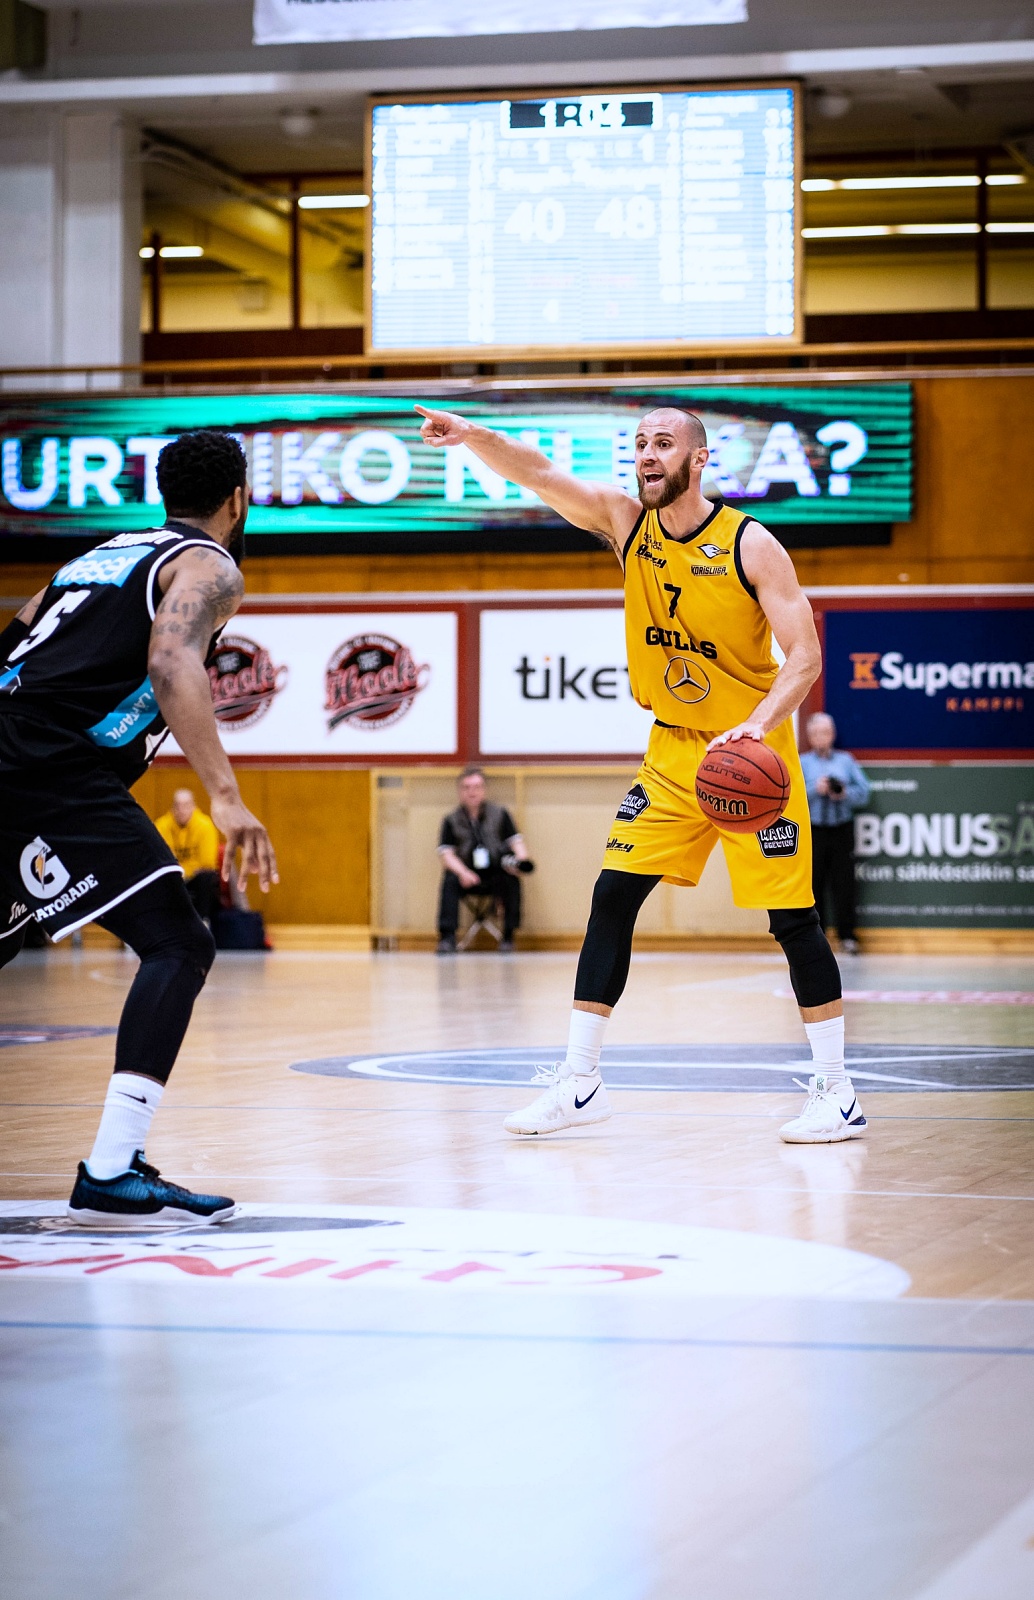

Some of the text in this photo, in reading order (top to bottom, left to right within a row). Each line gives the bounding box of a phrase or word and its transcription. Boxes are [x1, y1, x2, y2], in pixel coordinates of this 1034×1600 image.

[503, 195, 656, 243] 40 48
[1, 431, 411, 510] URTIKO
[664, 583, 681, 618] 7
[7, 589, 91, 662] 5
[696, 785, 749, 815] Wilson
[33, 874, 99, 923] ATORADE
